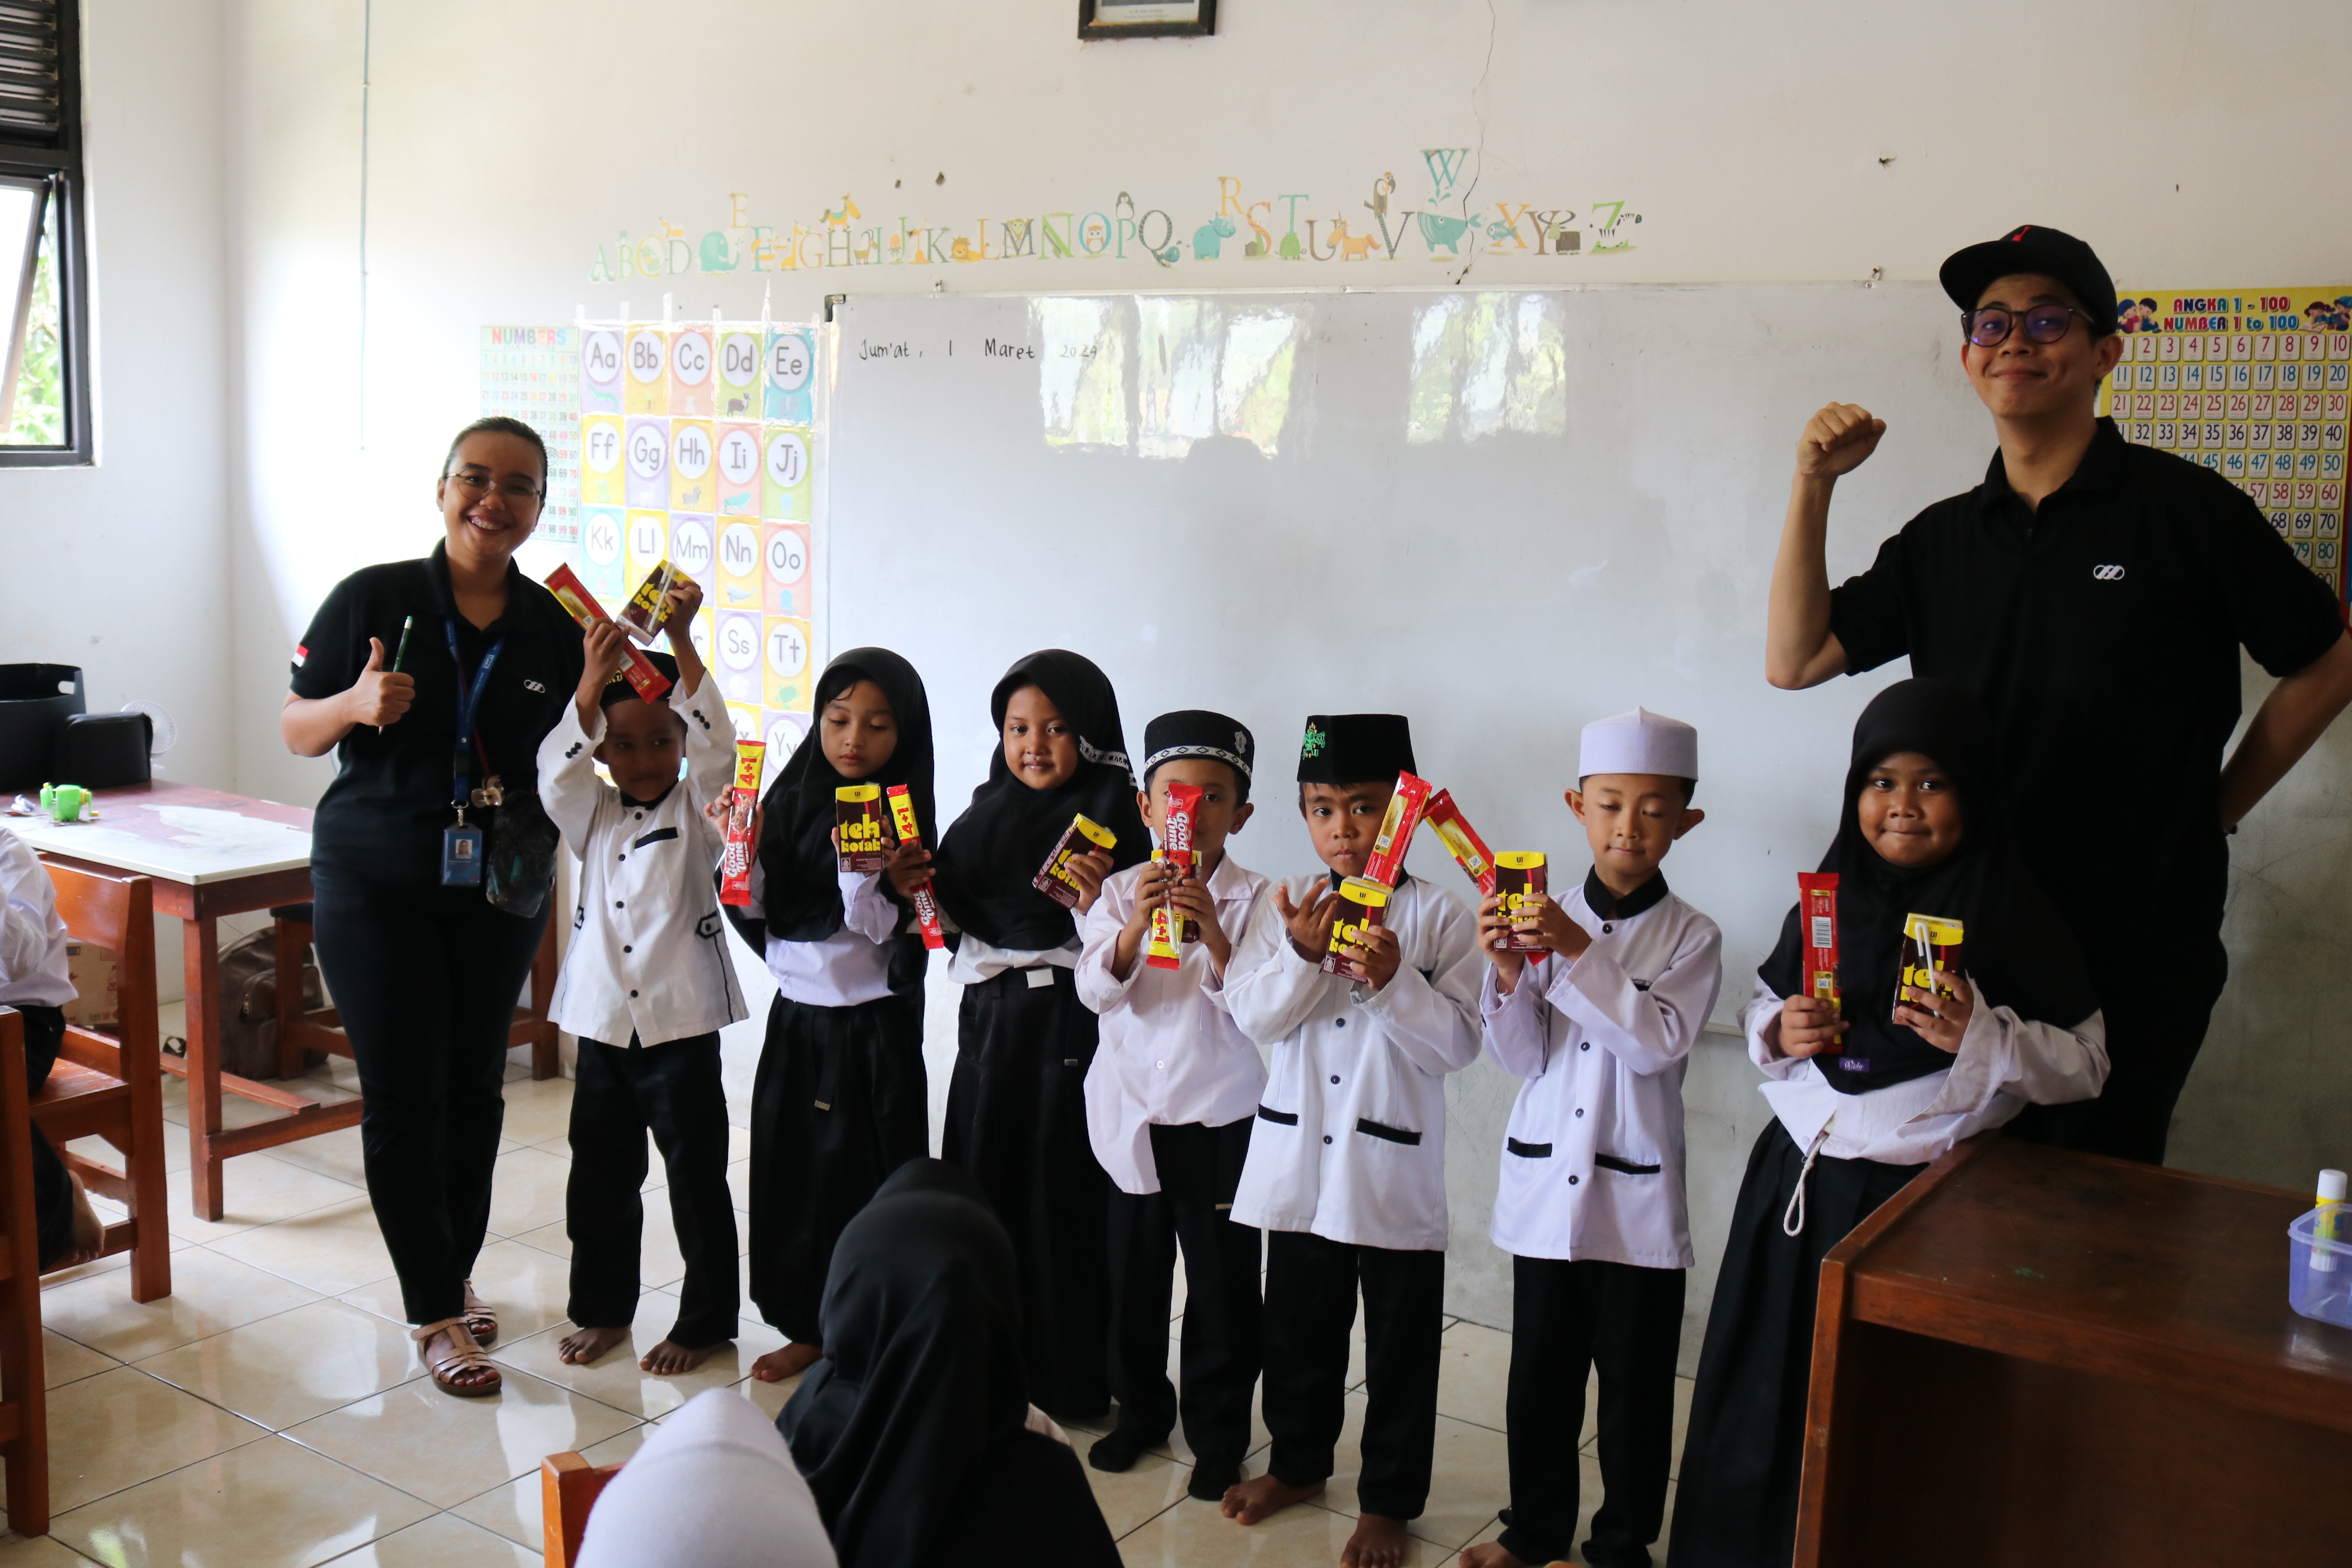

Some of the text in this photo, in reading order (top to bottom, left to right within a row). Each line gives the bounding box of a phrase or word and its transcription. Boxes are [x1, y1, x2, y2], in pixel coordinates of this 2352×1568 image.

[589, 242, 612, 279] A
[618, 245, 635, 278] B
[636, 234, 664, 277] C
[667, 239, 691, 275] D
[730, 193, 749, 228] E
[799, 233, 824, 269] G
[826, 231, 852, 267] H
[896, 217, 907, 261] J
[926, 227, 950, 263] K
[1001, 219, 1036, 258] M
[1038, 213, 1075, 259] N
[1079, 212, 1111, 254] O
[1115, 219, 1136, 259] P
[1138, 210, 1172, 267] Q
[1217, 177, 1247, 216] R
[1247, 202, 1272, 254] S
[1278, 194, 1309, 234] T
[1305, 220, 1340, 261] U
[1377, 211, 1415, 259] V
[1421, 149, 1469, 188] W
[1491, 203, 1531, 249] X
[1524, 210, 1562, 255] Y
[1591, 201, 1629, 253] Z
[2174, 298, 2227, 313] ANGKA
[2234, 297, 2241, 312] 1
[2260, 296, 2289, 312] 100
[2164, 315, 2299, 332] NUMBER 1 to 100
[491, 328, 566, 346] NUMBERS
[985, 338, 1035, 359] Maret
[1059, 344, 1097, 359] 2024
[2142, 338, 2151, 354] 2
[2166, 338, 2174, 353] 3
[2188, 337, 2198, 352] 4
[2213, 337, 2221, 352] 5
[2236, 337, 2246, 352] 6
[2261, 337, 2271, 352] 7
[2285, 337, 2294, 351] 8
[2310, 336, 2319, 351] 9
[2334, 335, 2347, 351] 10
[590, 347, 616, 368] Aa
[634, 342, 658, 368] Bb
[679, 344, 704, 370] Cc
[726, 344, 753, 373] Dd
[776, 347, 802, 375] Ee
[502, 372, 545, 382] 13 14 15 17
[2116, 365, 2346, 382] 11 12 13 14 15 16 17 18 19 20
[520, 391, 556, 401] 25 28
[2113, 396, 2344, 411] 21 22 23 24 25 26 27 28 29 30
[530, 411, 566, 421] 36 39
[549, 430, 556, 440] 48
[2134, 424, 2150, 440] 32
[2158, 424, 2174, 440] 33
[2181, 424, 2197, 440] 34
[2204, 424, 2220, 440] 35
[2229, 424, 2244, 440] 36
[2252, 424, 2269, 440] 37
[2276, 424, 2293, 440] 38
[2301, 424, 2318, 440] 39
[2325, 425, 2343, 441] 40
[558, 450, 567, 459] 59
[591, 433, 614, 459] Ff
[635, 436, 660, 469] Gg
[679, 437, 704, 465] Hh
[731, 442, 746, 469] Ii
[548, 469, 577, 478] 68 69 70
[776, 444, 798, 481] Jj
[2202, 454, 2218, 469] 45
[2226, 455, 2243, 469] 46
[2250, 455, 2268, 469] 47
[2274, 455, 2291, 470] 48
[2299, 455, 2316, 470] 49
[2323, 455, 2341, 471] 50
[2249, 483, 2338, 500] 57 58 59 60
[548, 507, 576, 515] 88 89 90
[2270, 513, 2336, 530] 68 69 70
[548, 524, 566, 533] 98 99
[591, 526, 613, 551] Kk
[676, 534, 708, 559] Mm
[726, 536, 751, 563] Nn
[772, 541, 800, 570] Oo
[2293, 543, 2334, 560] 79 80
[728, 629, 749, 654] Ss
[773, 634, 800, 663] Tt
[740, 757, 757, 786] 4+1
[839, 814, 880, 839] teh
[897, 807, 913, 835] 4+1
[1176, 811, 1190, 851] Good
[841, 838, 881, 853] kotak
[1165, 817, 1179, 851] Time
[726, 842, 738, 878] Good
[734, 841, 746, 873] Time
[913, 893, 930, 926] Good
[918, 890, 935, 920] Time
[1154, 910, 1170, 943] 4+1
